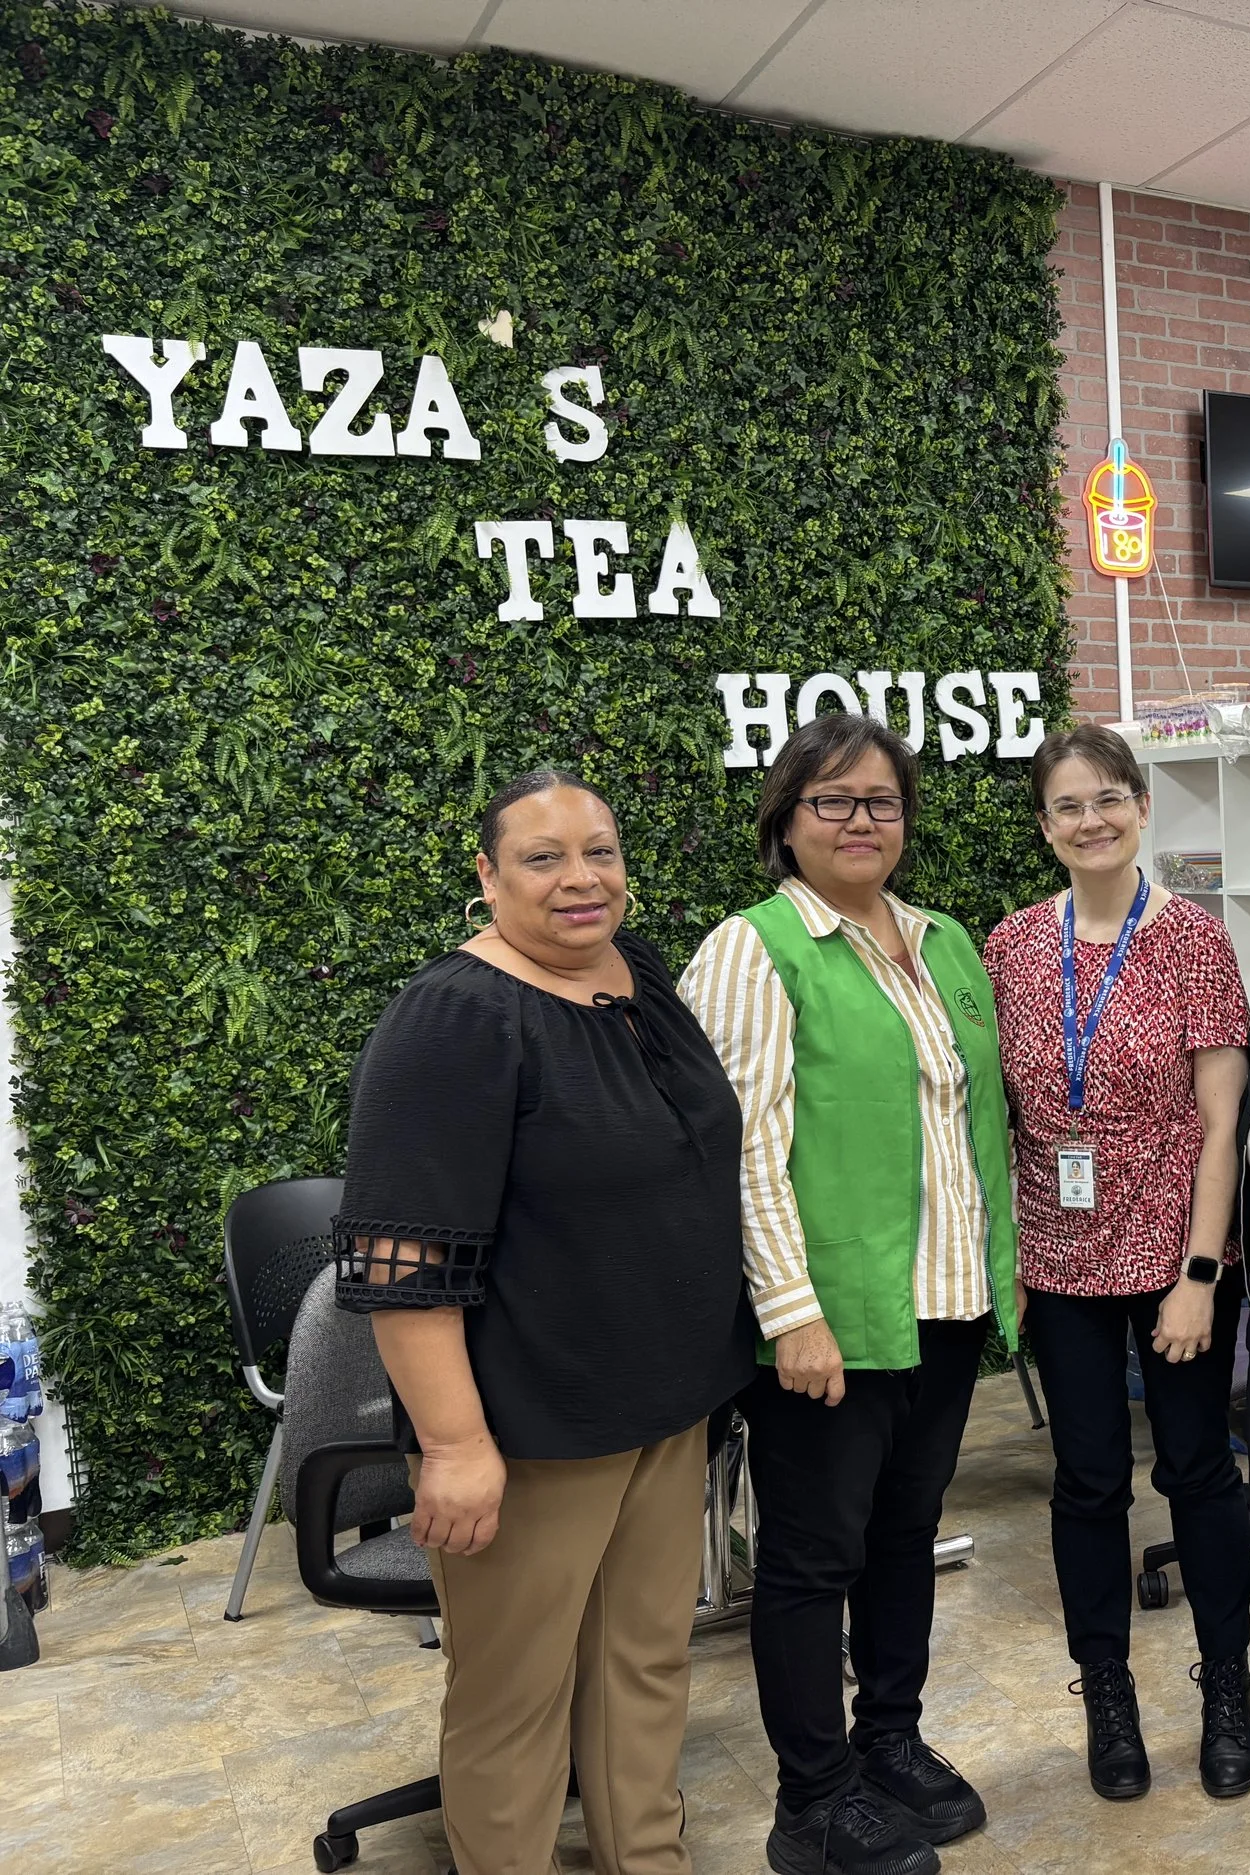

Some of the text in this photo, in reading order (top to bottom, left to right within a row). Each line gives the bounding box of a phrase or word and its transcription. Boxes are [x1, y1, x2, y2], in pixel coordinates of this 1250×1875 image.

[102, 334, 482, 460] YAZA
[475, 520, 721, 622] TEA
[1116, 926, 1133, 958] FREDERICK
[1093, 986, 1110, 1017] FREDERICK
[1076, 1047, 1087, 1081] FREDERICK
